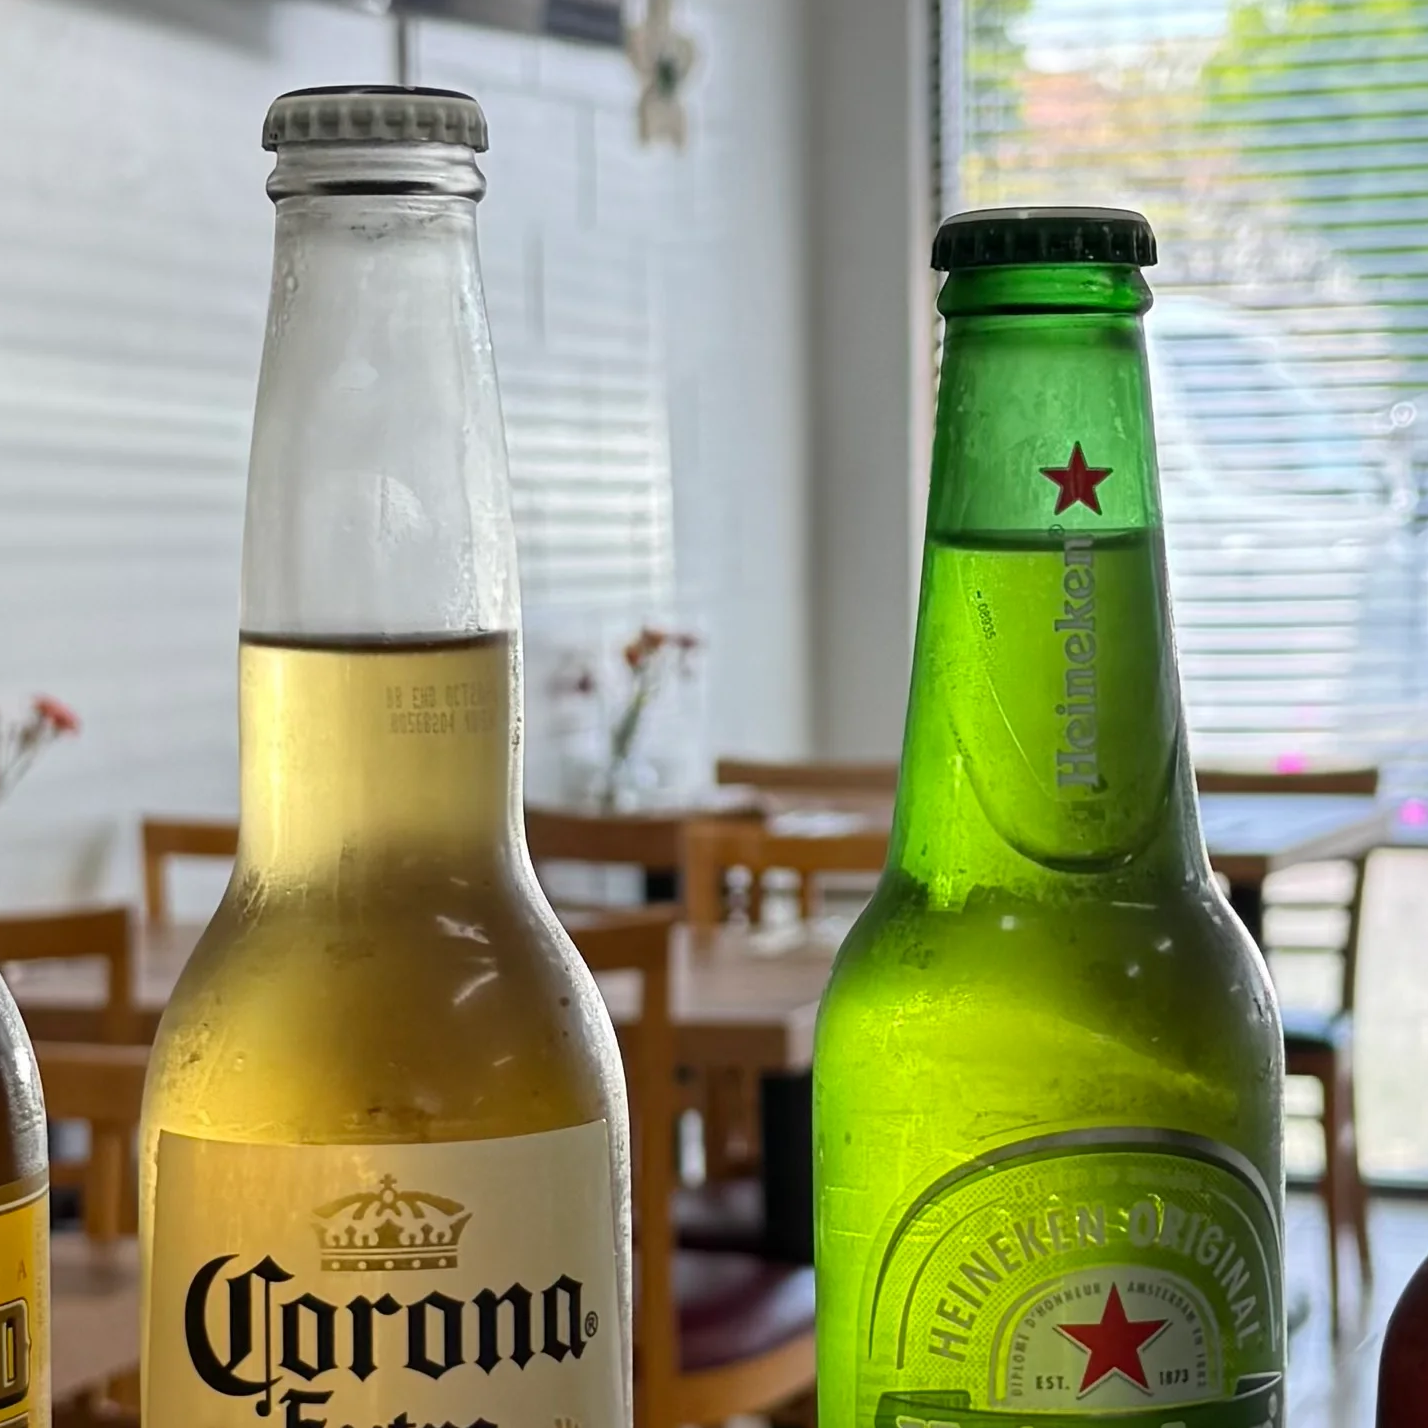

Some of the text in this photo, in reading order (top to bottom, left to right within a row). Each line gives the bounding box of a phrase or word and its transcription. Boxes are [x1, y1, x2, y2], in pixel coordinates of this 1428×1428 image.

[927, 1200, 1263, 1363] HEINEKEN ORIGINAL
[1036, 1376, 1070, 1390] EST.
